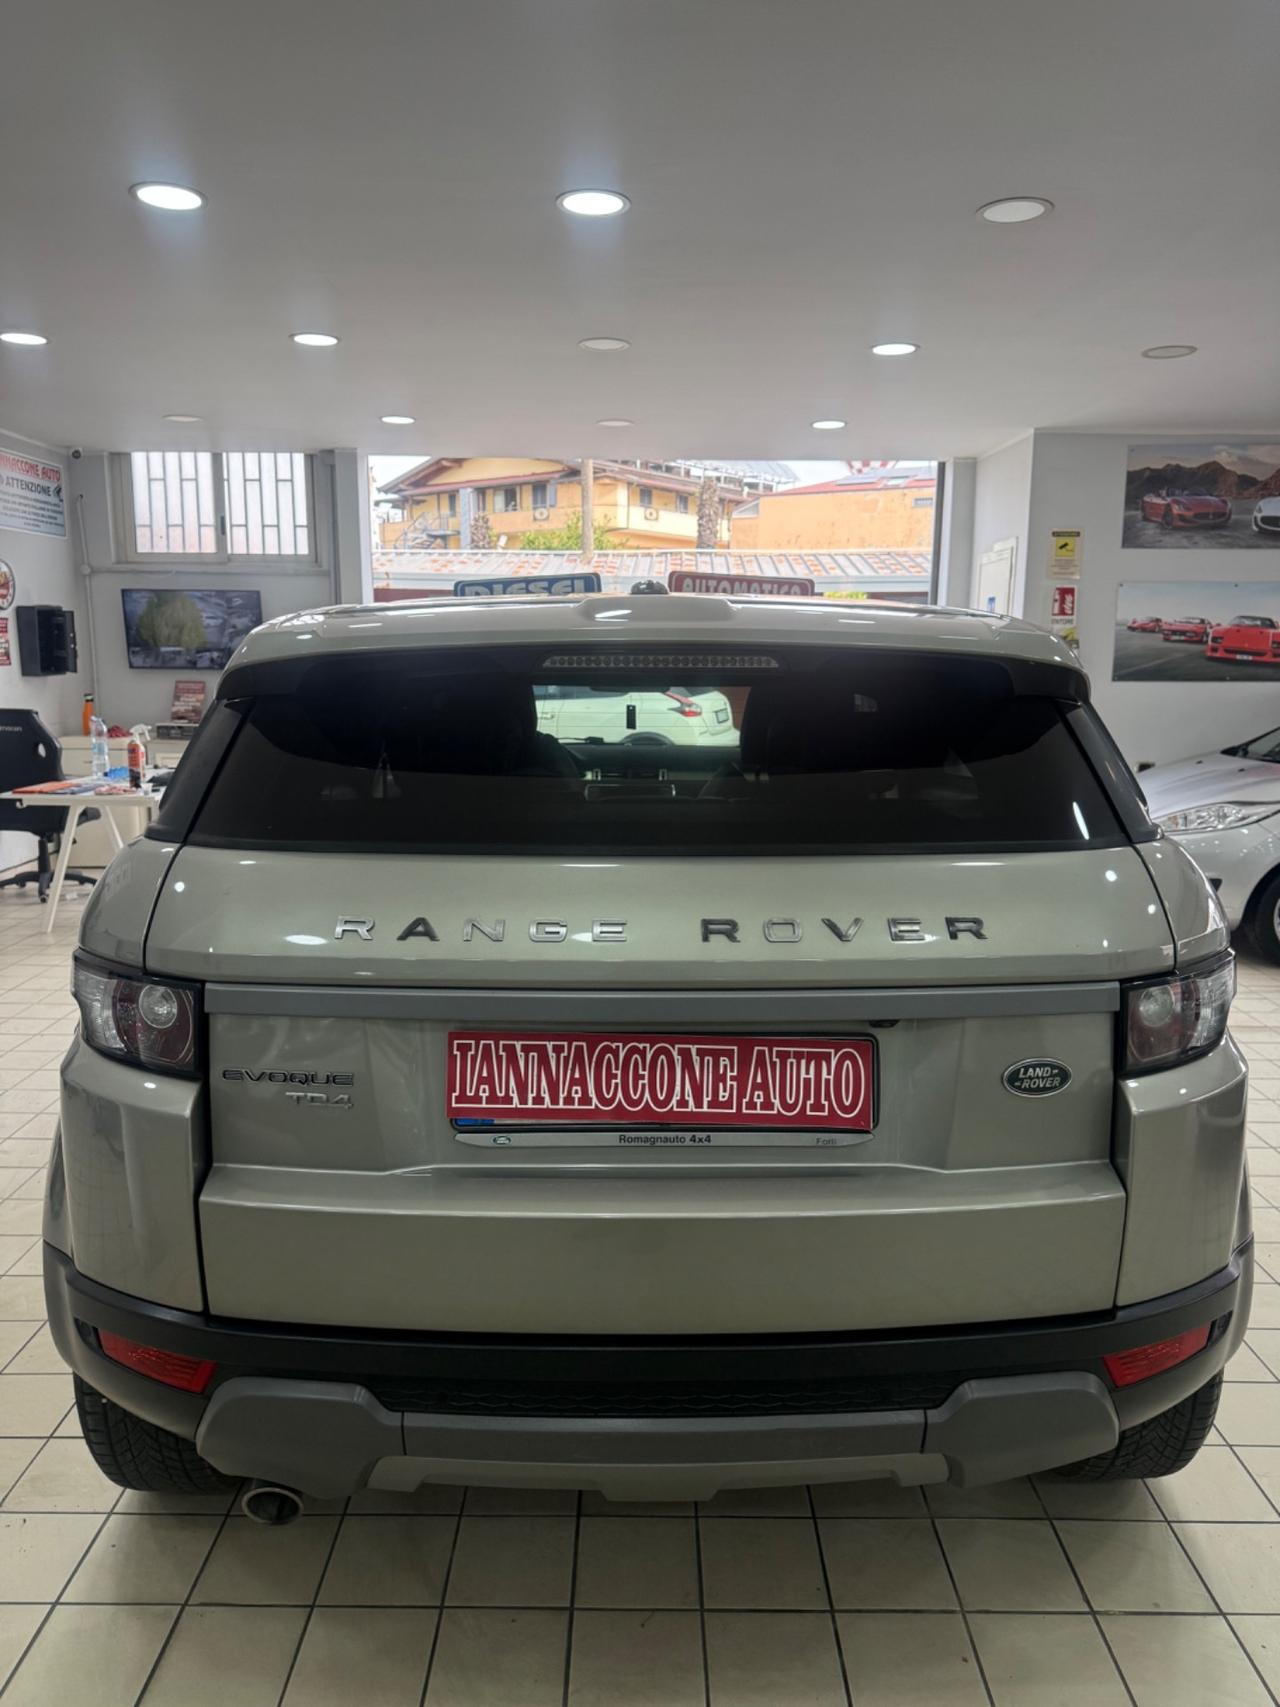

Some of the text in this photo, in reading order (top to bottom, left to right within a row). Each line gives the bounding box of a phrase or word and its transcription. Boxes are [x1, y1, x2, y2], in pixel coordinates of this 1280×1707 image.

[5, 475, 52, 497] ATTENZIONE
[334, 916, 988, 943] RANGE ROVER
[222, 1068, 354, 1087] EVOQUE
[452, 1040, 865, 1118] IANNACCONE AUTO
[1018, 1066, 1052, 1079] LAND
[1021, 1077, 1061, 1089] ROVER
[285, 1091, 354, 1110] TD4
[618, 1133, 712, 1146] Romagnauto 4x4
